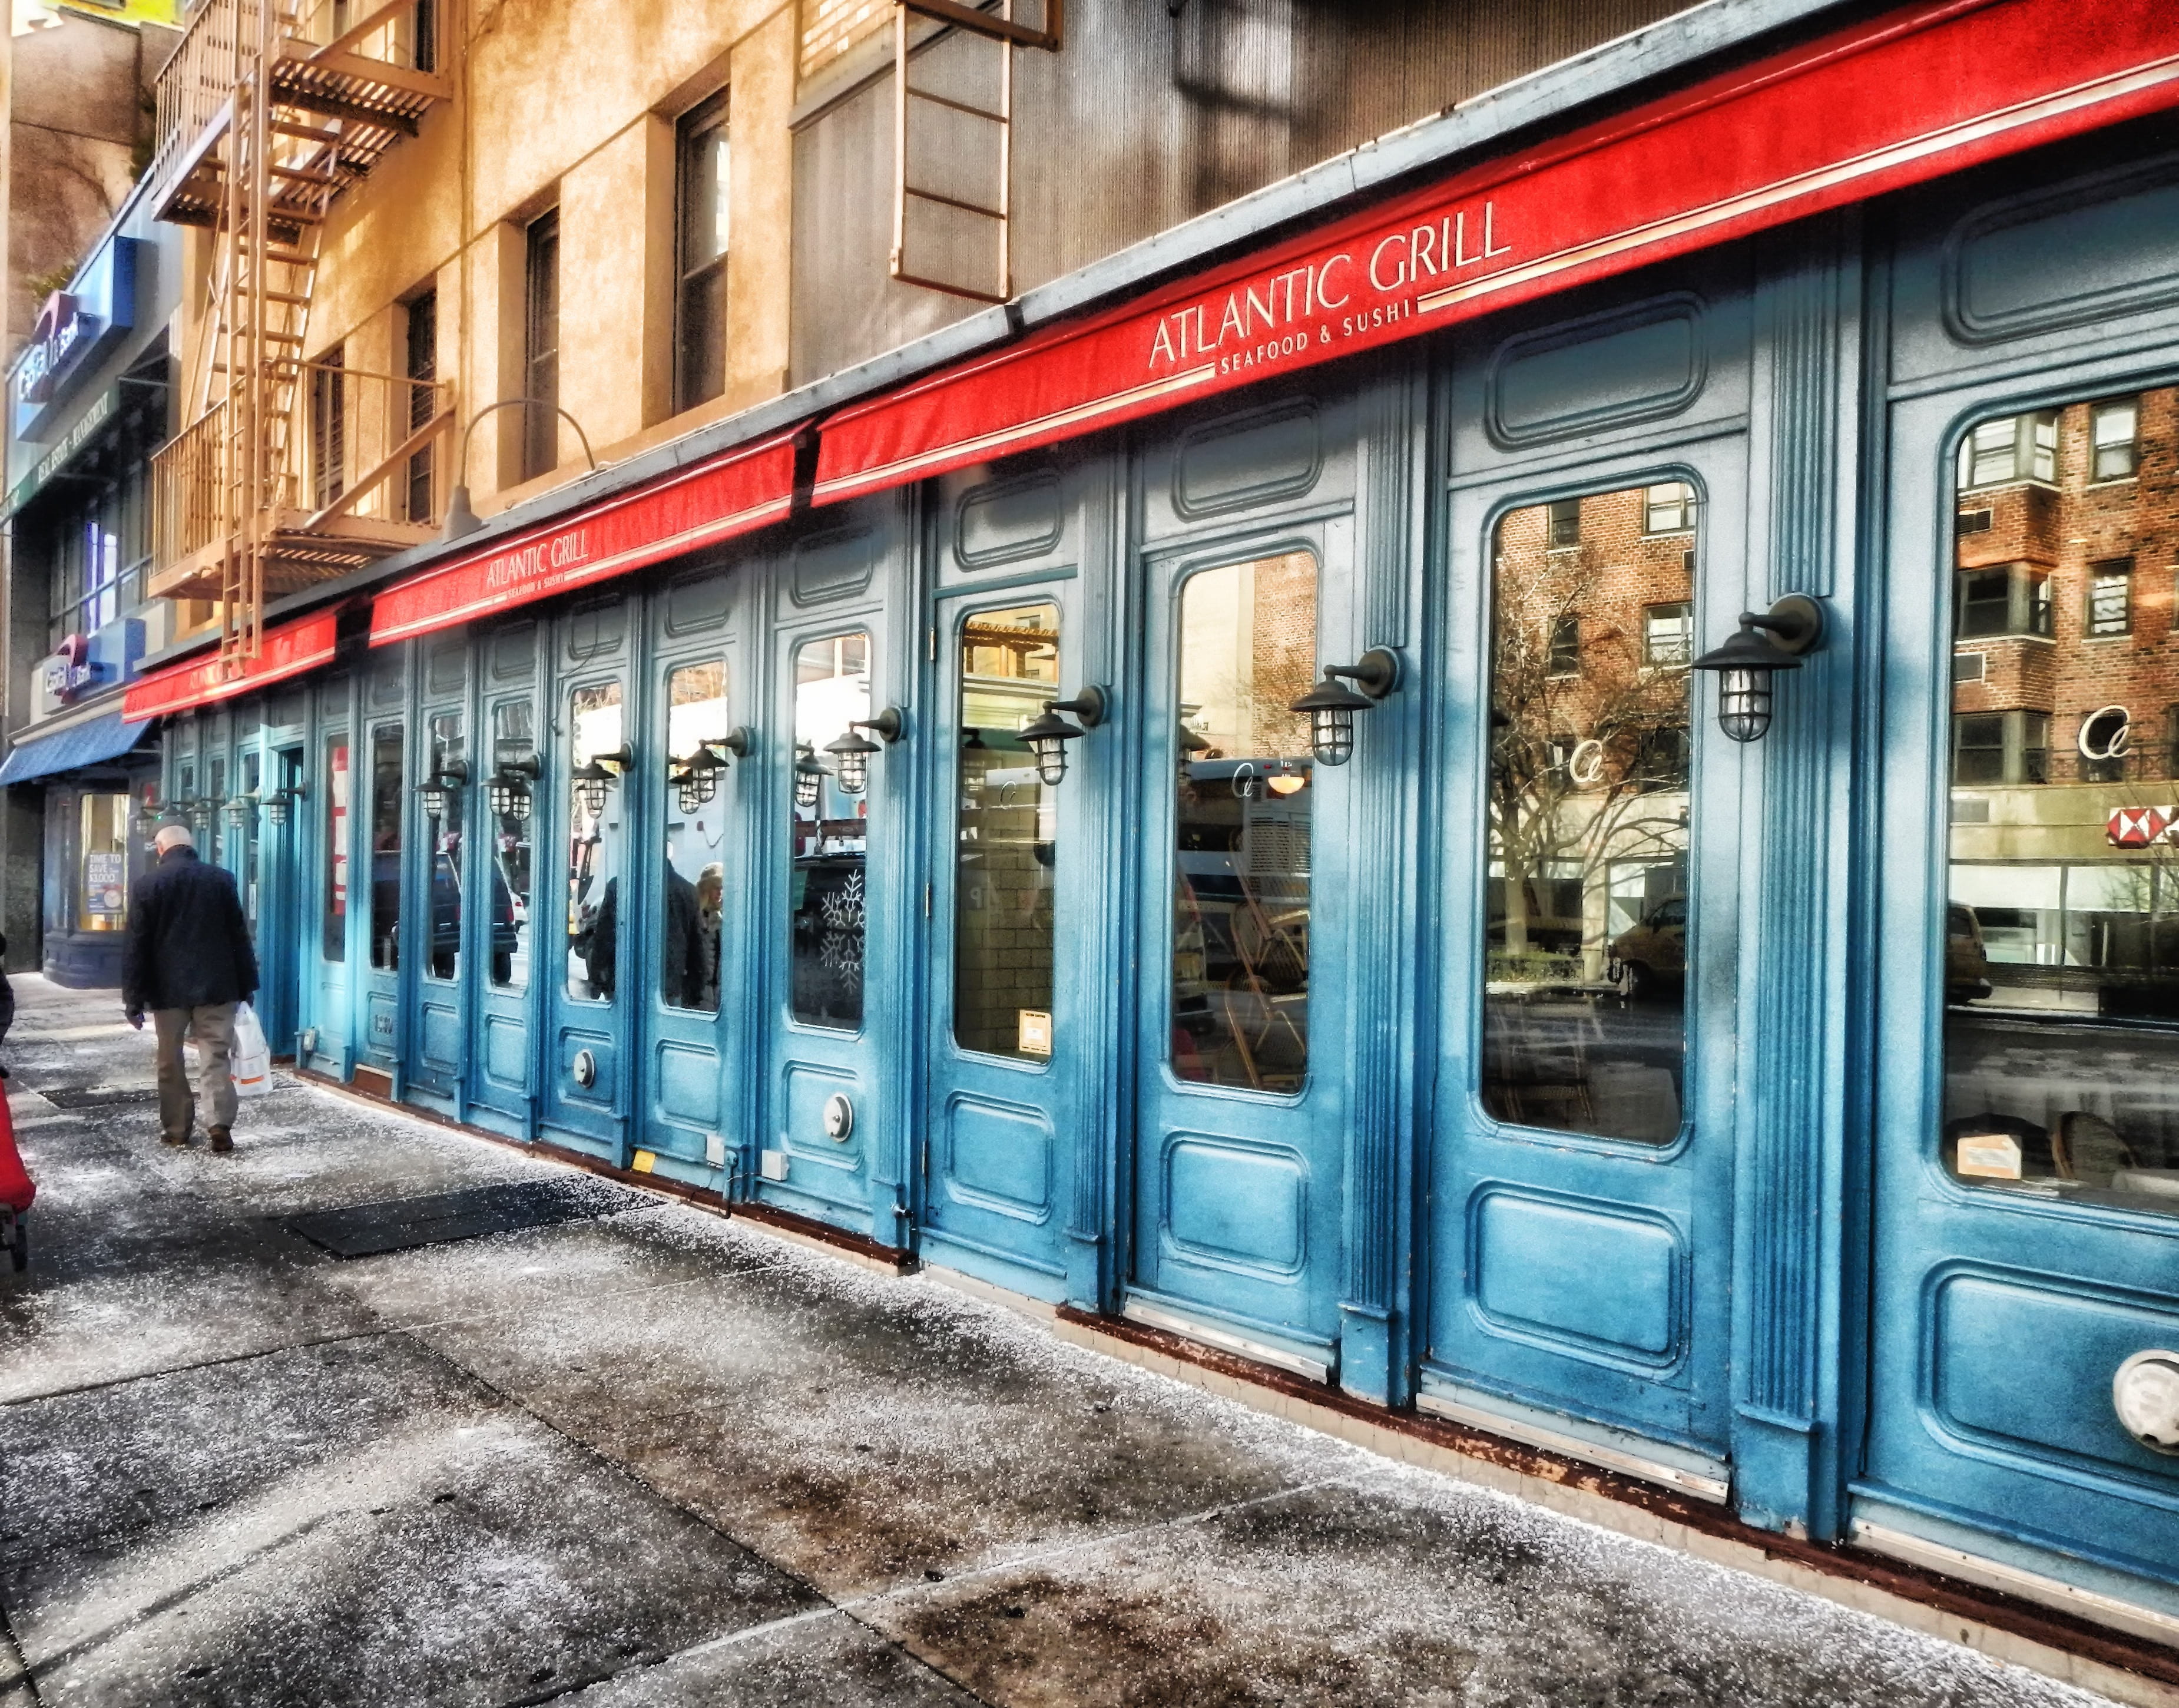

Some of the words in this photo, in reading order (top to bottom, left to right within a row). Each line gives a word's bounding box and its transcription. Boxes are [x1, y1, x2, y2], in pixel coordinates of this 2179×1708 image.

[1148, 254, 1351, 368] ATLANTIC
[1369, 201, 1512, 292] GRILL
[1220, 332, 1309, 375] SEAFOOD
[1320, 324, 1332, 343] &
[1343, 298, 1410, 337] SUSHI
[486, 543, 547, 588] ATLANTIC
[551, 529, 589, 568] GRILL
[90, 864, 108, 873] SAVE
[109, 854, 121, 864] TO
